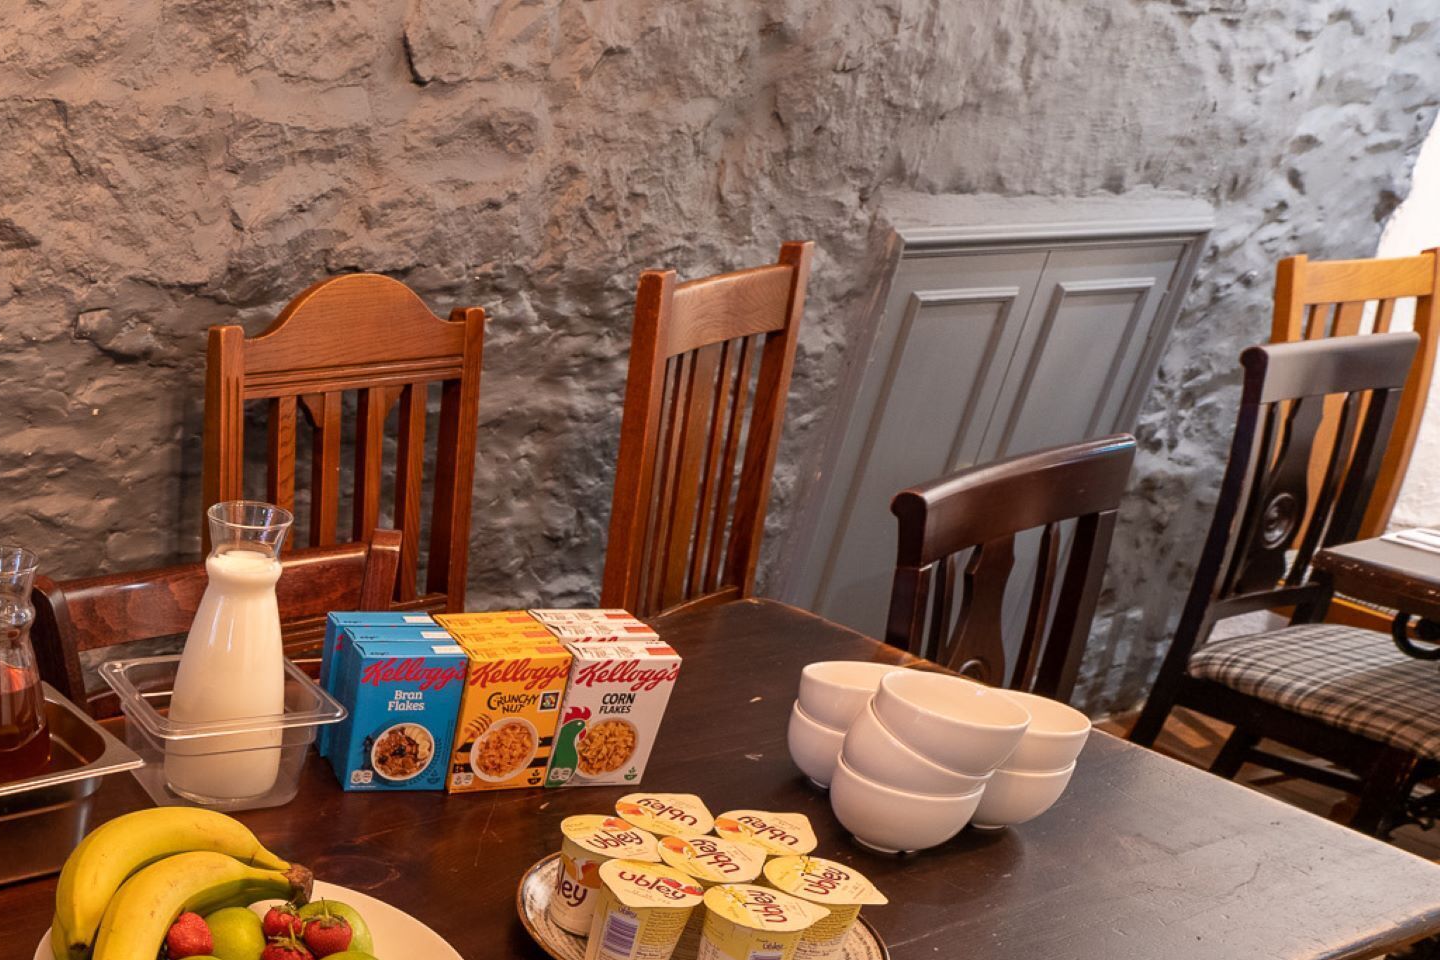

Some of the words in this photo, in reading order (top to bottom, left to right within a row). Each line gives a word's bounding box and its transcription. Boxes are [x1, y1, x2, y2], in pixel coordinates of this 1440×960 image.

[361, 657, 467, 690] Kellogg's
[470, 658, 571, 690] Kellogg's
[576, 659, 679, 691] Kellogg's
[394, 690, 423, 700] Bran
[602, 693, 636, 705] CORN
[388, 700, 425, 712] Flakes
[487, 692, 540, 711] CRUNCHY
[502, 704, 525, 714] NUT
[598, 705, 631, 714] FLAKES
